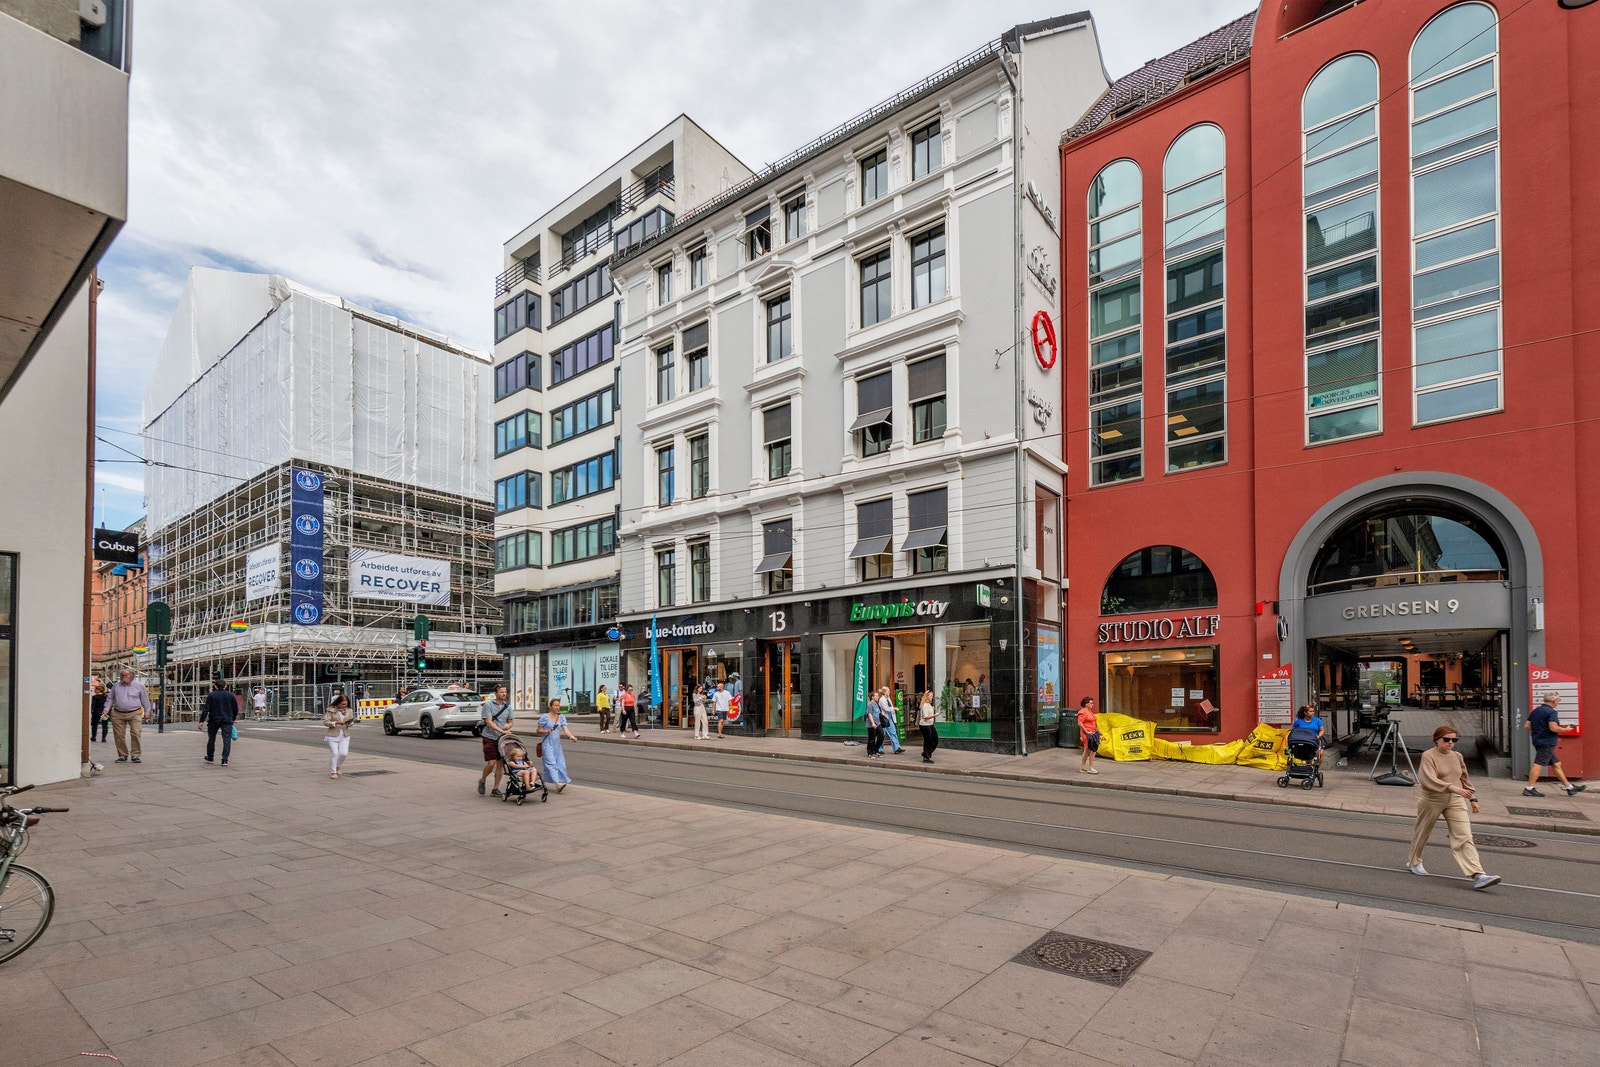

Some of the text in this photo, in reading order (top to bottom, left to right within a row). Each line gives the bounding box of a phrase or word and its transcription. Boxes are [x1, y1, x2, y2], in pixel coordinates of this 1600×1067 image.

[1321, 389, 1351, 400] NORGES
[99, 540, 135, 553] Cubus
[248, 569, 276, 587] RECOVER
[360, 561, 398, 572] Arbeidet
[400, 566, 430, 577] utføres
[360, 574, 440, 593] RECOVER
[850, 597, 950, 624] Europris City
[1342, 599, 1459, 620] GRENSEN 9
[645, 621, 716, 639] bue-tomato
[768, 611, 786, 632] 13
[1098, 614, 1221, 644] STUDIO ALF
[552, 658, 569, 667] LOKALE
[599, 655, 618, 664] LOKALE
[608, 663, 618, 671] LEIE
[856, 655, 866, 702] Europris
[1531, 670, 1550, 680] 9B
